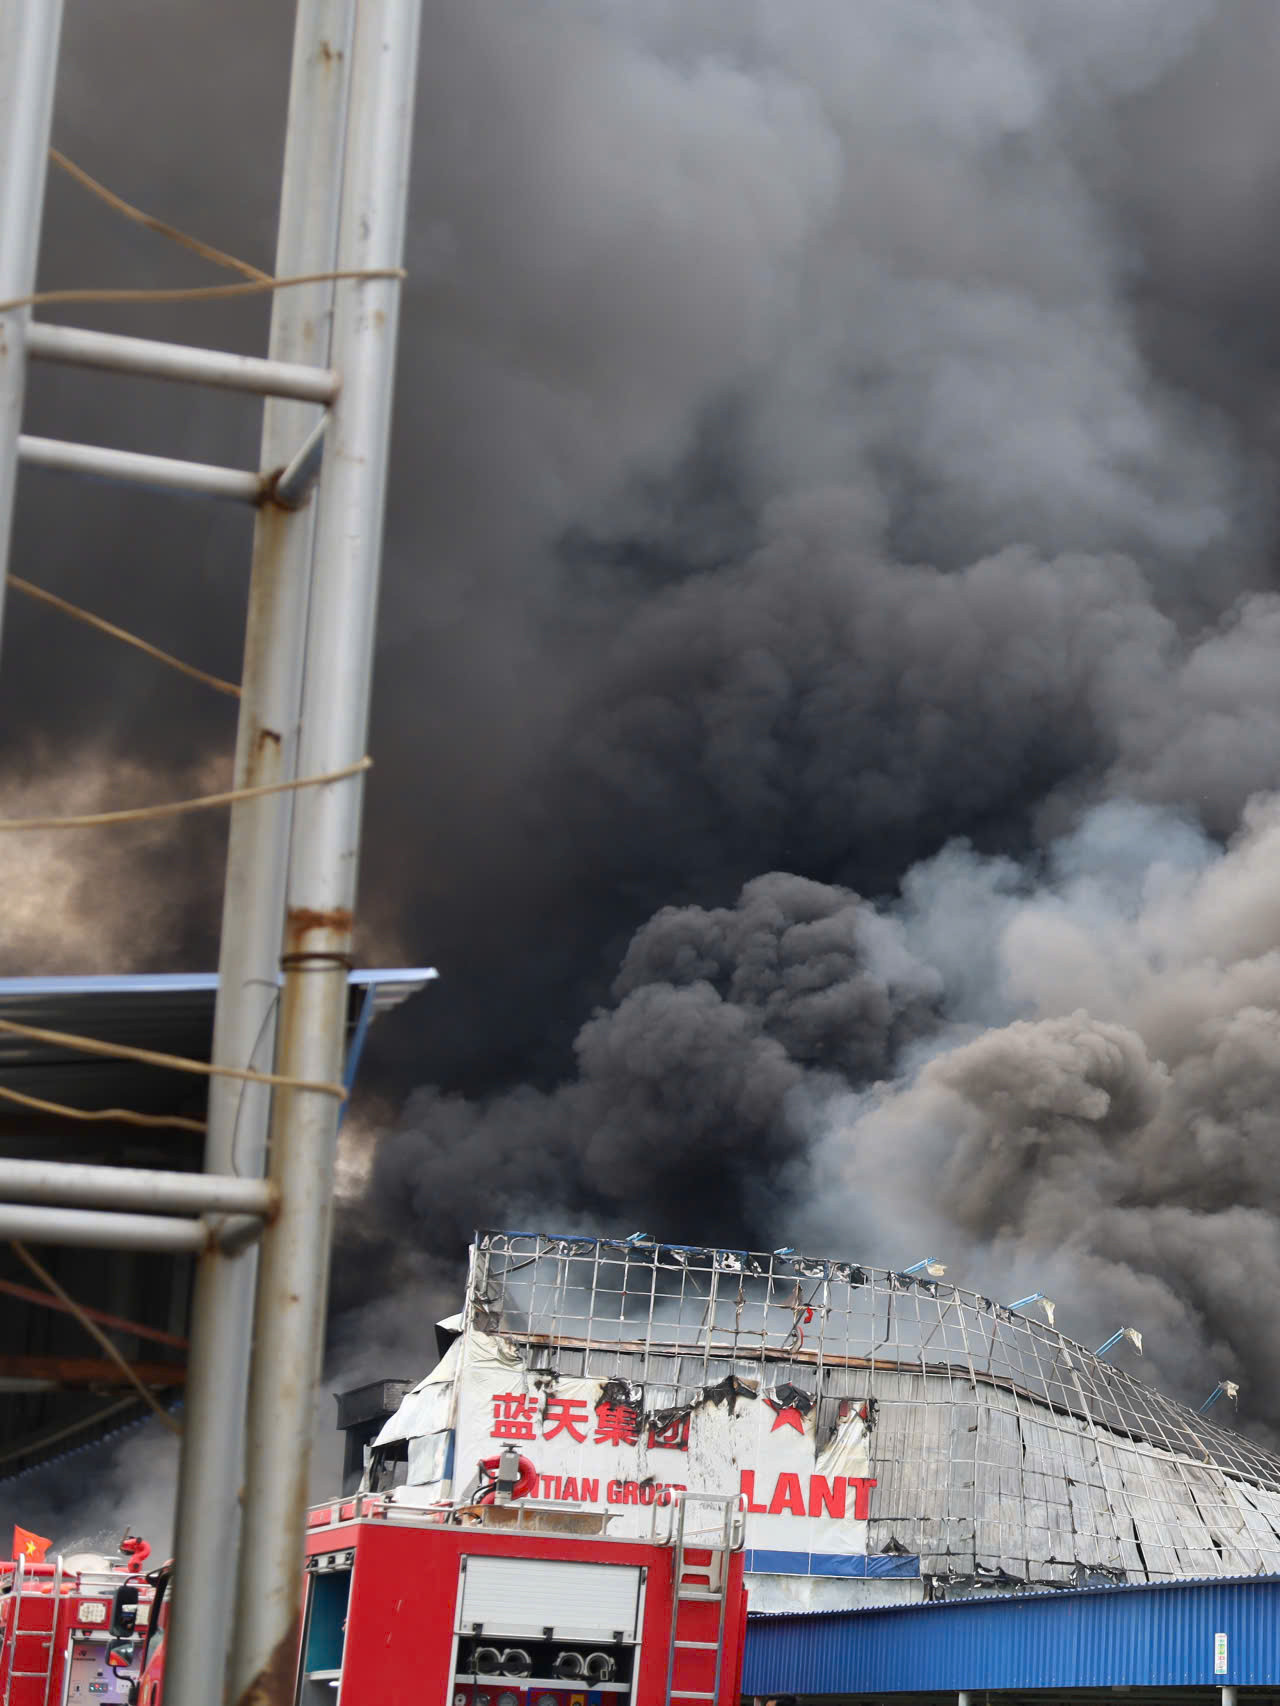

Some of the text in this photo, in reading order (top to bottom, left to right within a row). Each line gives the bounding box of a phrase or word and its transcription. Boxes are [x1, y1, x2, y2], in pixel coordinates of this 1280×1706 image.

[490, 1392, 690, 1451] 蓝天集团
[489, 1472, 600, 1503] NTIAN
[739, 1469, 877, 1520] LANT
